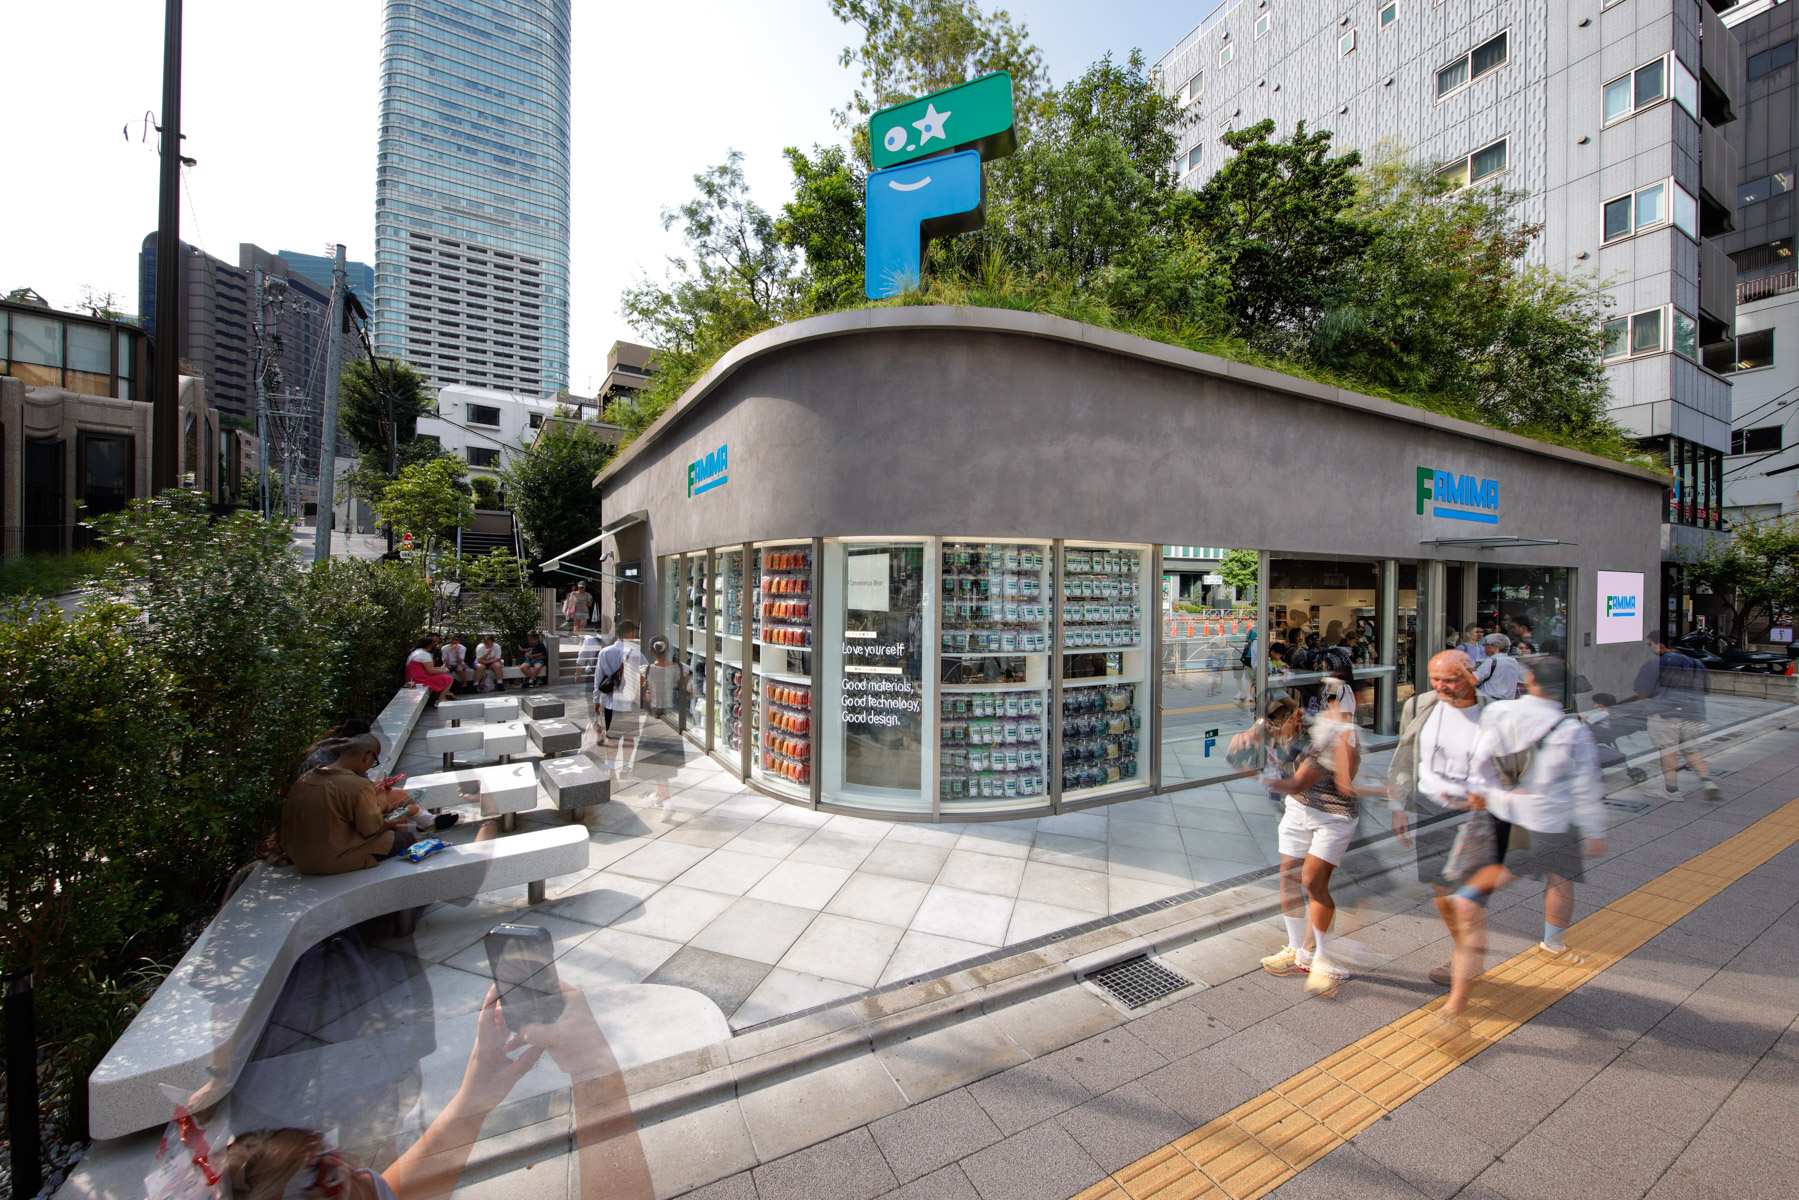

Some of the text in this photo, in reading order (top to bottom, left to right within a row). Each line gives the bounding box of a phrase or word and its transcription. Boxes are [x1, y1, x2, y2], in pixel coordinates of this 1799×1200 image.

[687, 443, 728, 498] FAMIMA
[1416, 466, 1499, 515] FAMIMA
[1606, 595, 1636, 618] FAMIMA
[842, 641, 905, 657] Love yourself
[842, 678, 914, 694] Good materials,
[842, 694, 920, 712] Good technology,
[842, 710, 901, 726] Good design.
